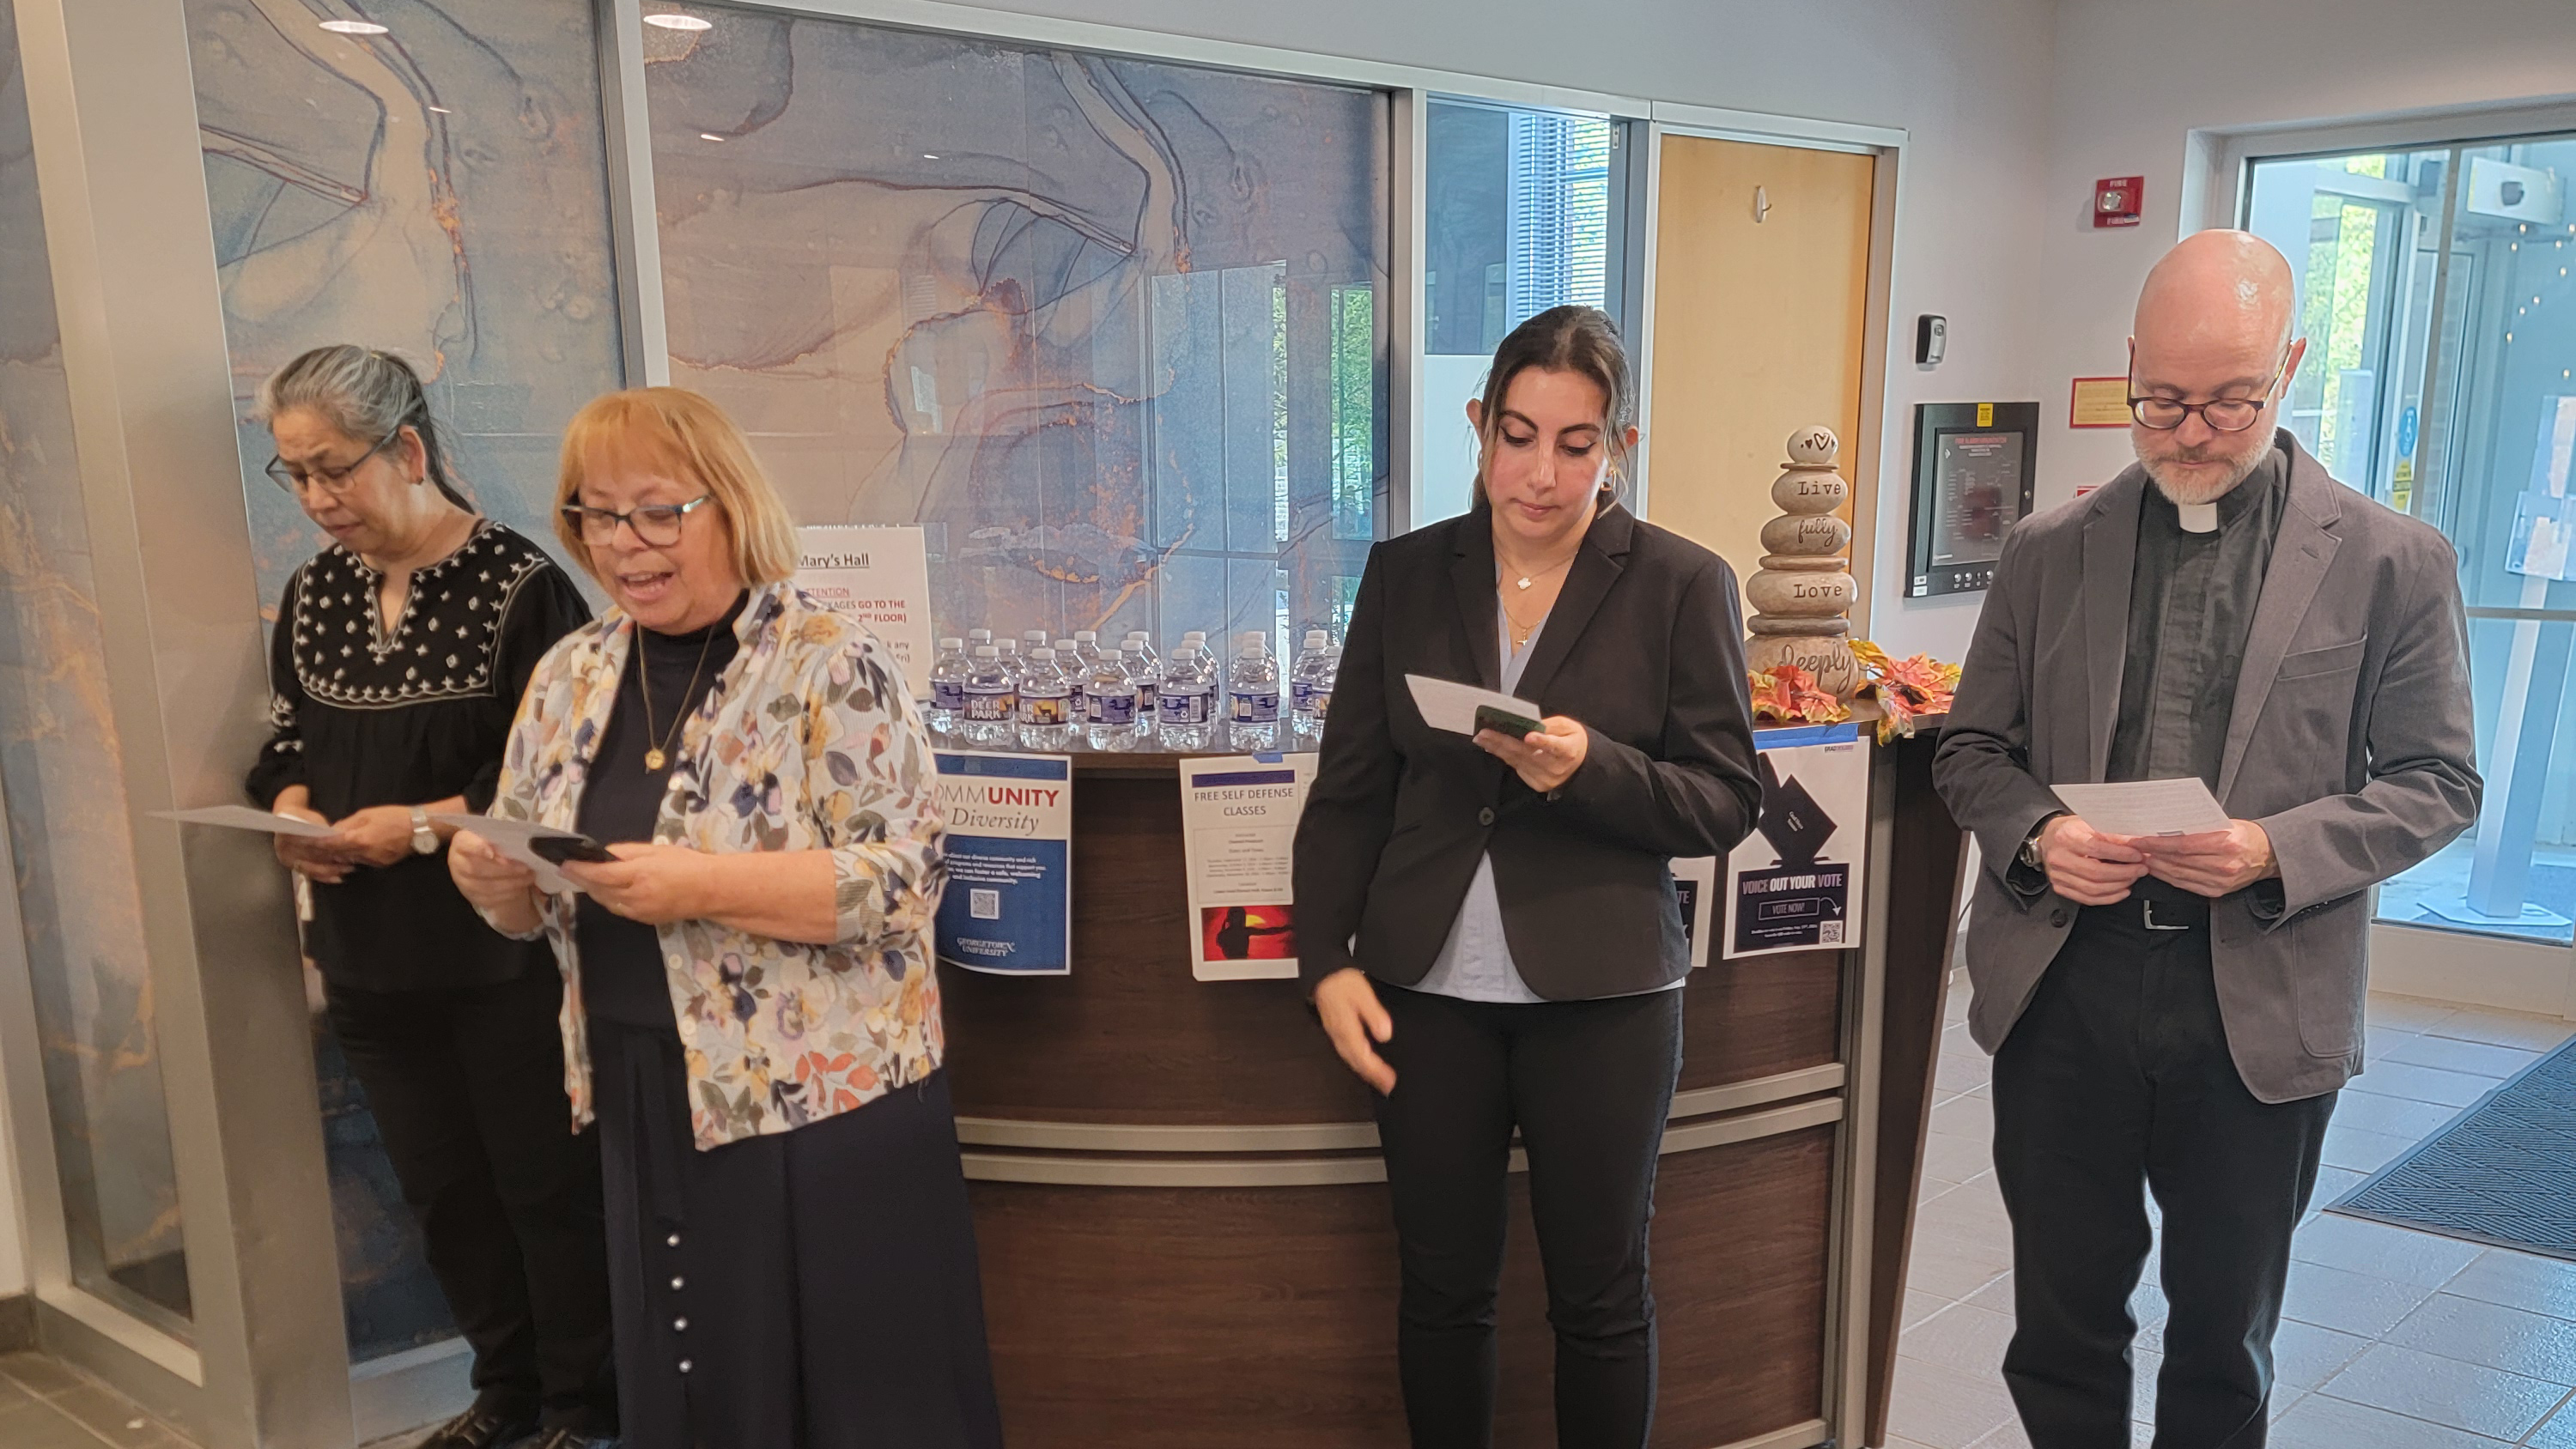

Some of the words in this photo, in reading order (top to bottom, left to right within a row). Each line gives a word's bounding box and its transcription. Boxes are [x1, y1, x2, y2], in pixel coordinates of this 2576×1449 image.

[1797, 481, 1841, 495] Live
[1798, 518, 1838, 547] fully
[844, 553, 869, 567] Hall
[1794, 584, 1842, 598] Love
[859, 601, 872, 609] GO
[875, 600, 885, 609] TO
[888, 600, 905, 609] THE
[874, 613, 907, 623] FLOOR)
[970, 700, 999, 710] DEER
[971, 709, 1001, 720] PARK
[1194, 791, 1219, 802] FREE
[1222, 790, 1245, 800] SELF
[1248, 788, 1294, 799] DEFENSE
[1224, 806, 1267, 816] CLASSES
[951, 808, 1039, 836] Diversity
[1742, 879, 1769, 894] VOICE
[1770, 876, 1789, 892] OUT
[1789, 875, 1816, 890] YOUR
[1818, 873, 1844, 888] VOTE
[1772, 904, 1787, 915] VOTE
[1788, 902, 1806, 914] NOW!
[957, 937, 1016, 953] GEORGETOWN
[962, 945, 1009, 956] UNIVERSITY
